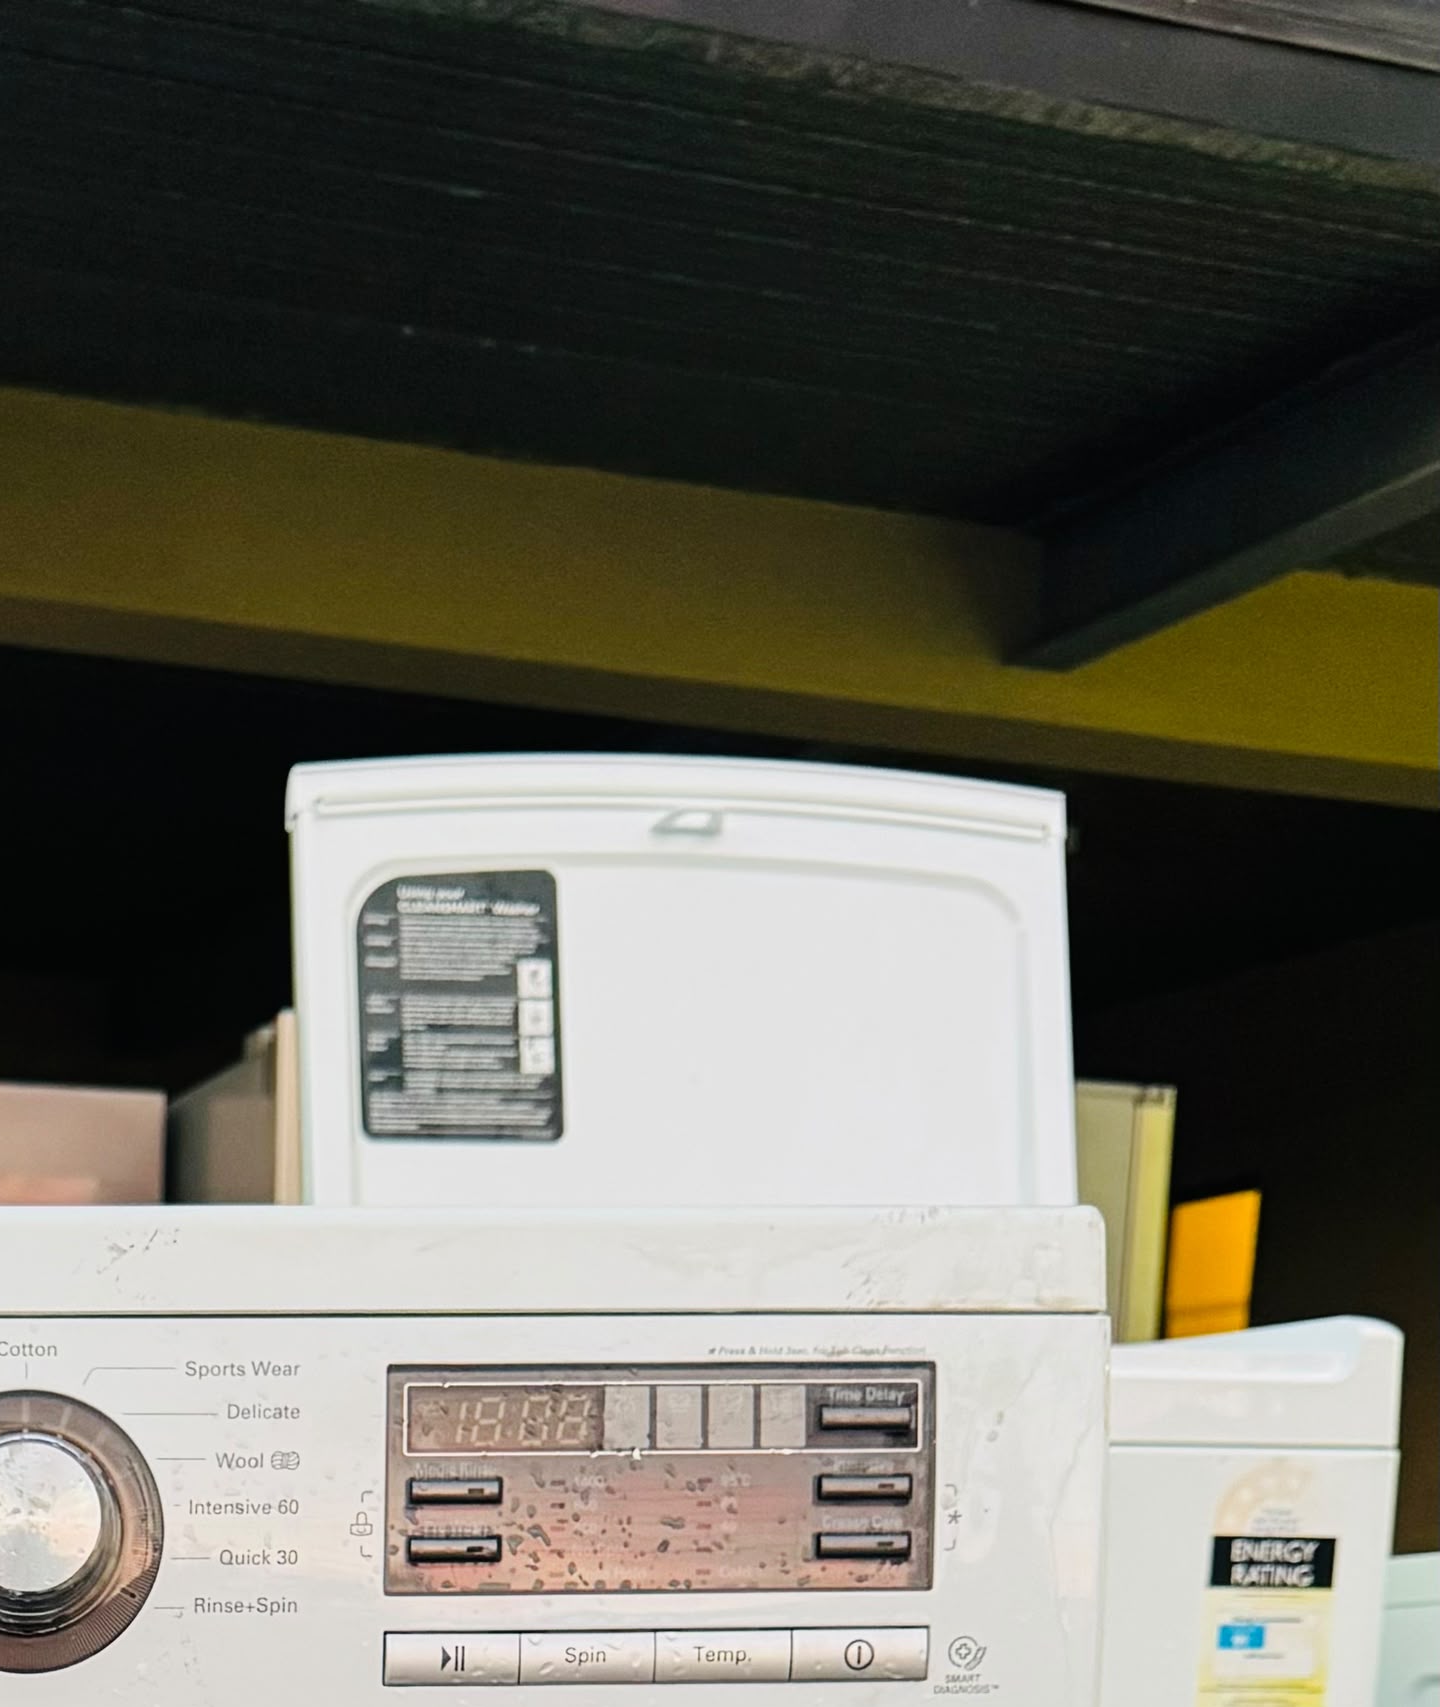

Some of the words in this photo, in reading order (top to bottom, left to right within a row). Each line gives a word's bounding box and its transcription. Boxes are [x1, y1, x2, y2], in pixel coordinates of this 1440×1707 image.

[184, 1361, 246, 1380] Sports
[251, 1361, 301, 1377] Wear
[826, 1388, 862, 1402] Time
[865, 1387, 906, 1406] Delay
[226, 1404, 301, 1420] Delicate
[215, 1452, 264, 1470] Wool
[188, 1499, 272, 1516] Intensive
[277, 1499, 300, 1516] 60
[218, 1549, 271, 1567] Quick
[276, 1550, 298, 1566] 30
[1230, 1538, 1320, 1563] ENERGY
[1230, 1563, 1315, 1588] RATING
[193, 1597, 298, 1617] Rinse+Spin
[565, 1646, 607, 1667] Spin
[693, 1645, 753, 1667] Temp.
